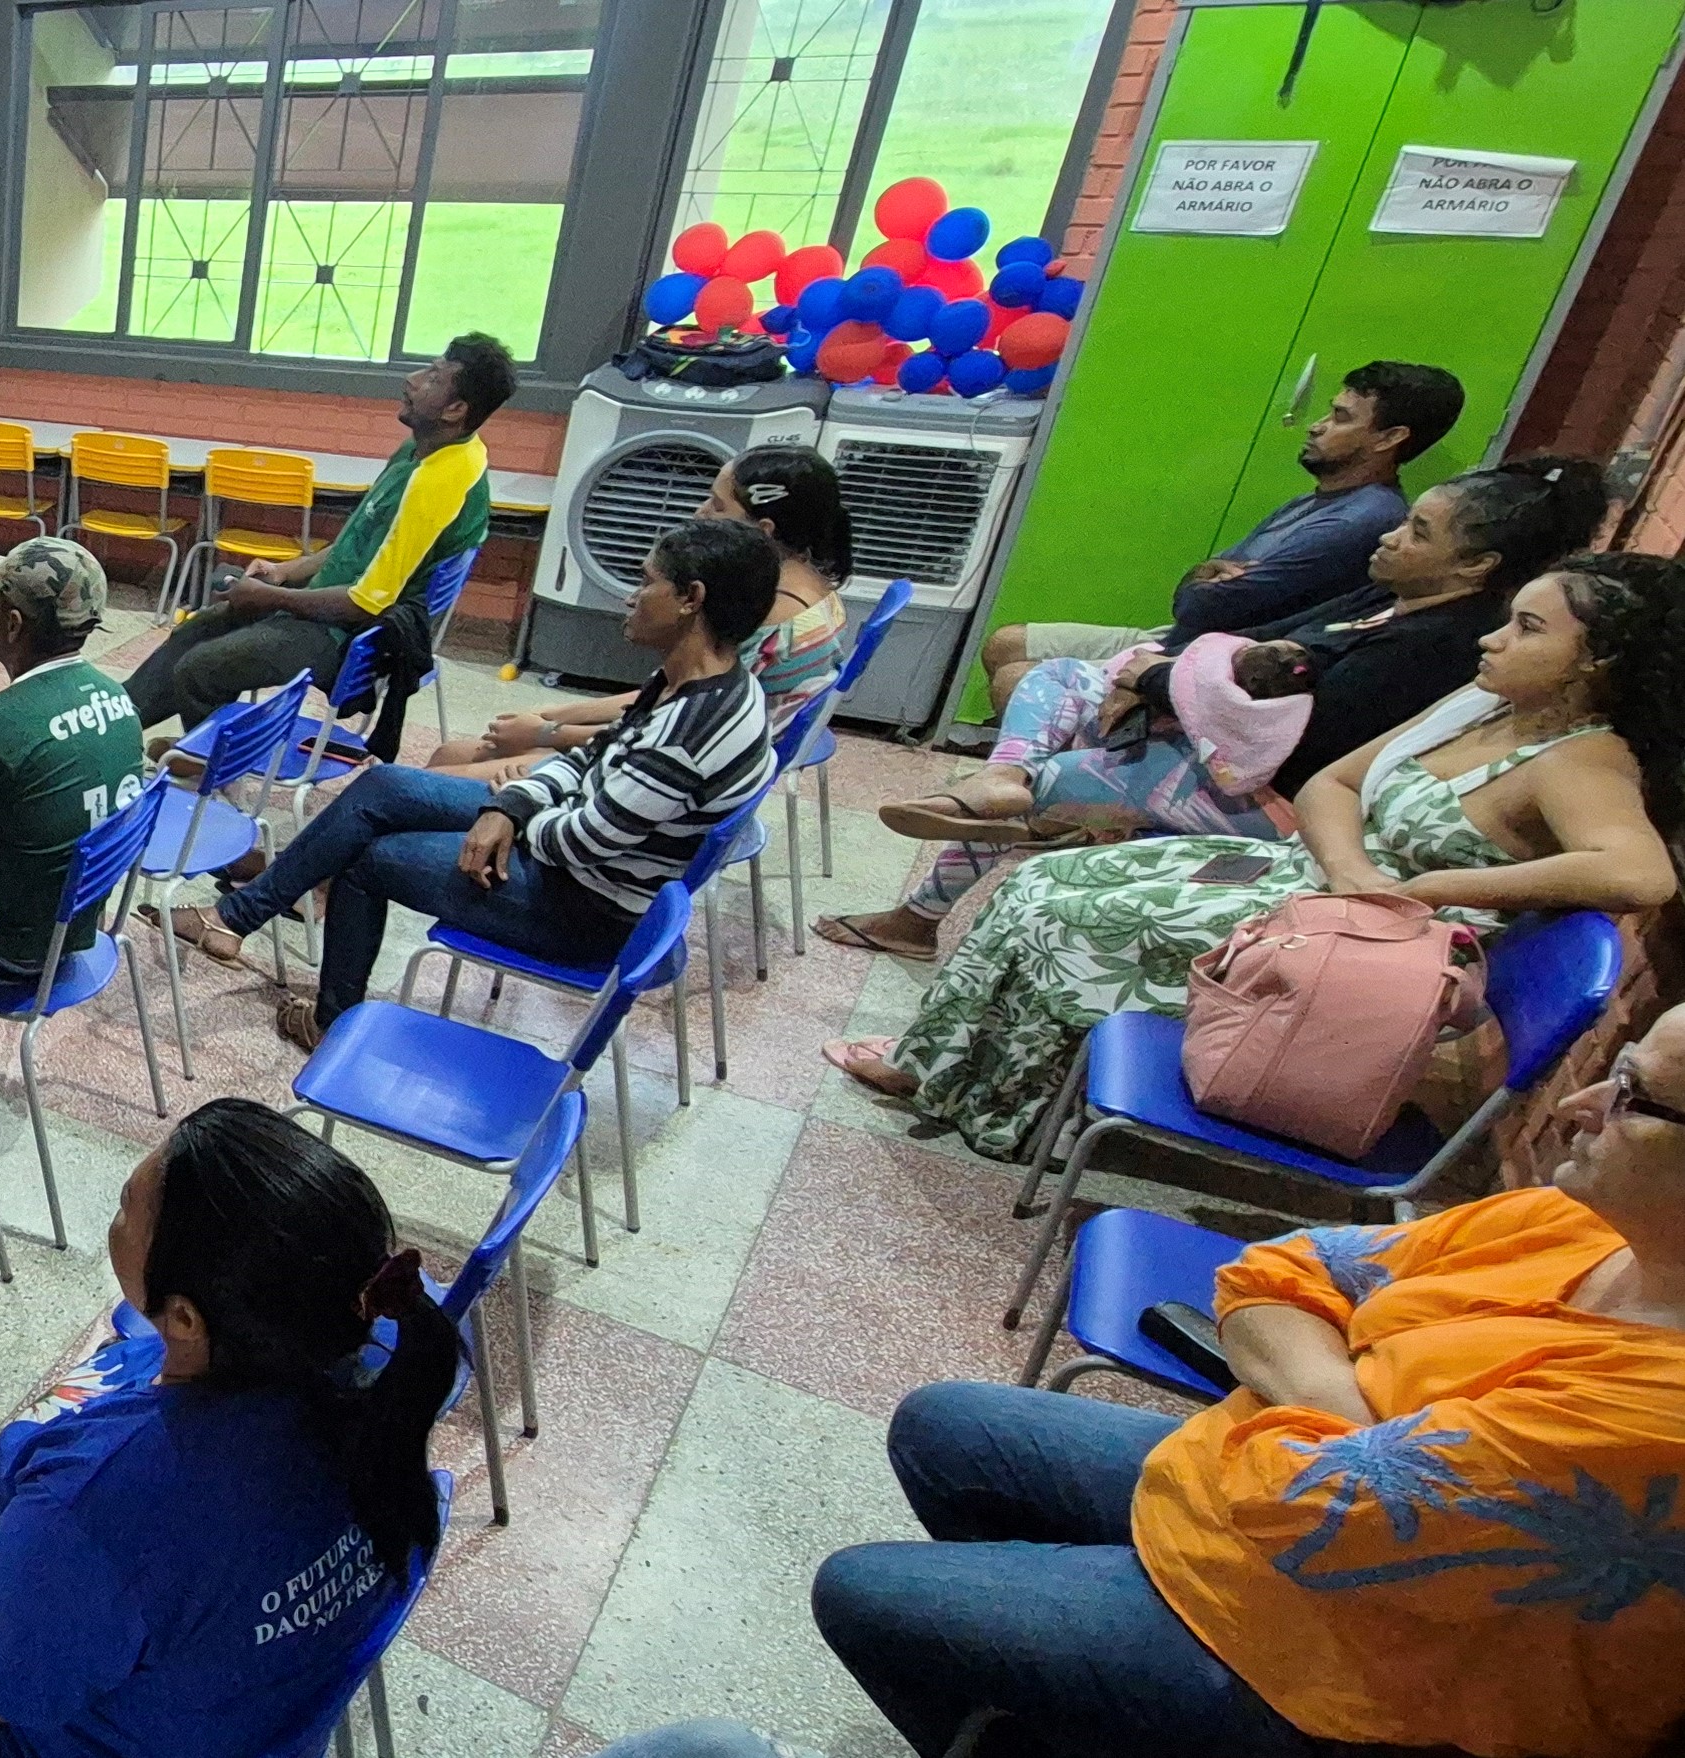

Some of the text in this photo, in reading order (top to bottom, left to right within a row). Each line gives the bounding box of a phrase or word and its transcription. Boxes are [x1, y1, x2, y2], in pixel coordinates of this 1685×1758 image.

[1184, 159, 1277, 172] POR FAVOR
[1171, 177, 1273, 192] NÃO ABRA O
[1419, 174, 1533, 191] NÃO ABRA O
[1175, 198, 1253, 212] ARMÁRIO
[1421, 197, 1510, 213] ARMÁRIO
[49, 690, 135, 741] crefisa
[261, 1525, 362, 1614] O FUTURO
[254, 1562, 354, 1645] DAQUILO
